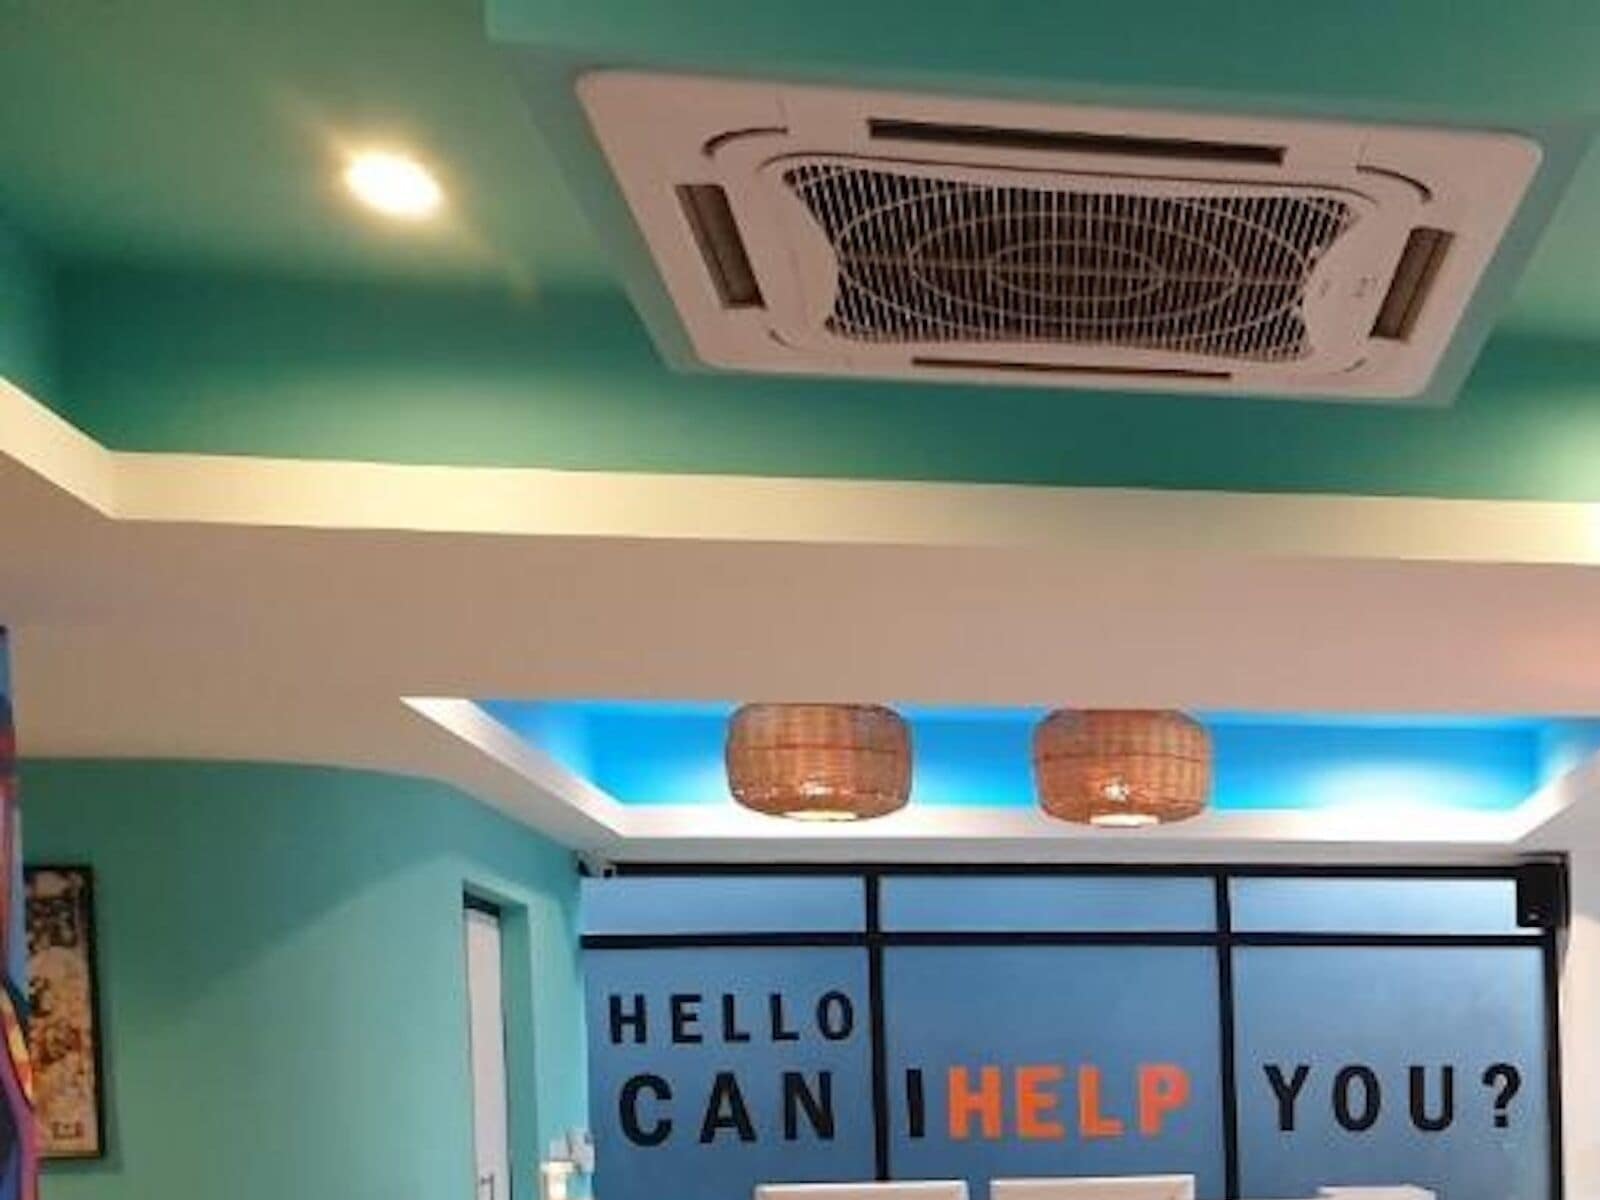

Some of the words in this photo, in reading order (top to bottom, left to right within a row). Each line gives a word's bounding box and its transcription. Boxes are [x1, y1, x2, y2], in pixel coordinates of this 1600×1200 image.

[608, 991, 854, 1044] HELLO
[618, 1069, 836, 1147] CAN
[905, 1068, 926, 1139] I
[948, 1064, 1190, 1140] HELP
[1262, 1063, 1523, 1134] YOU?
